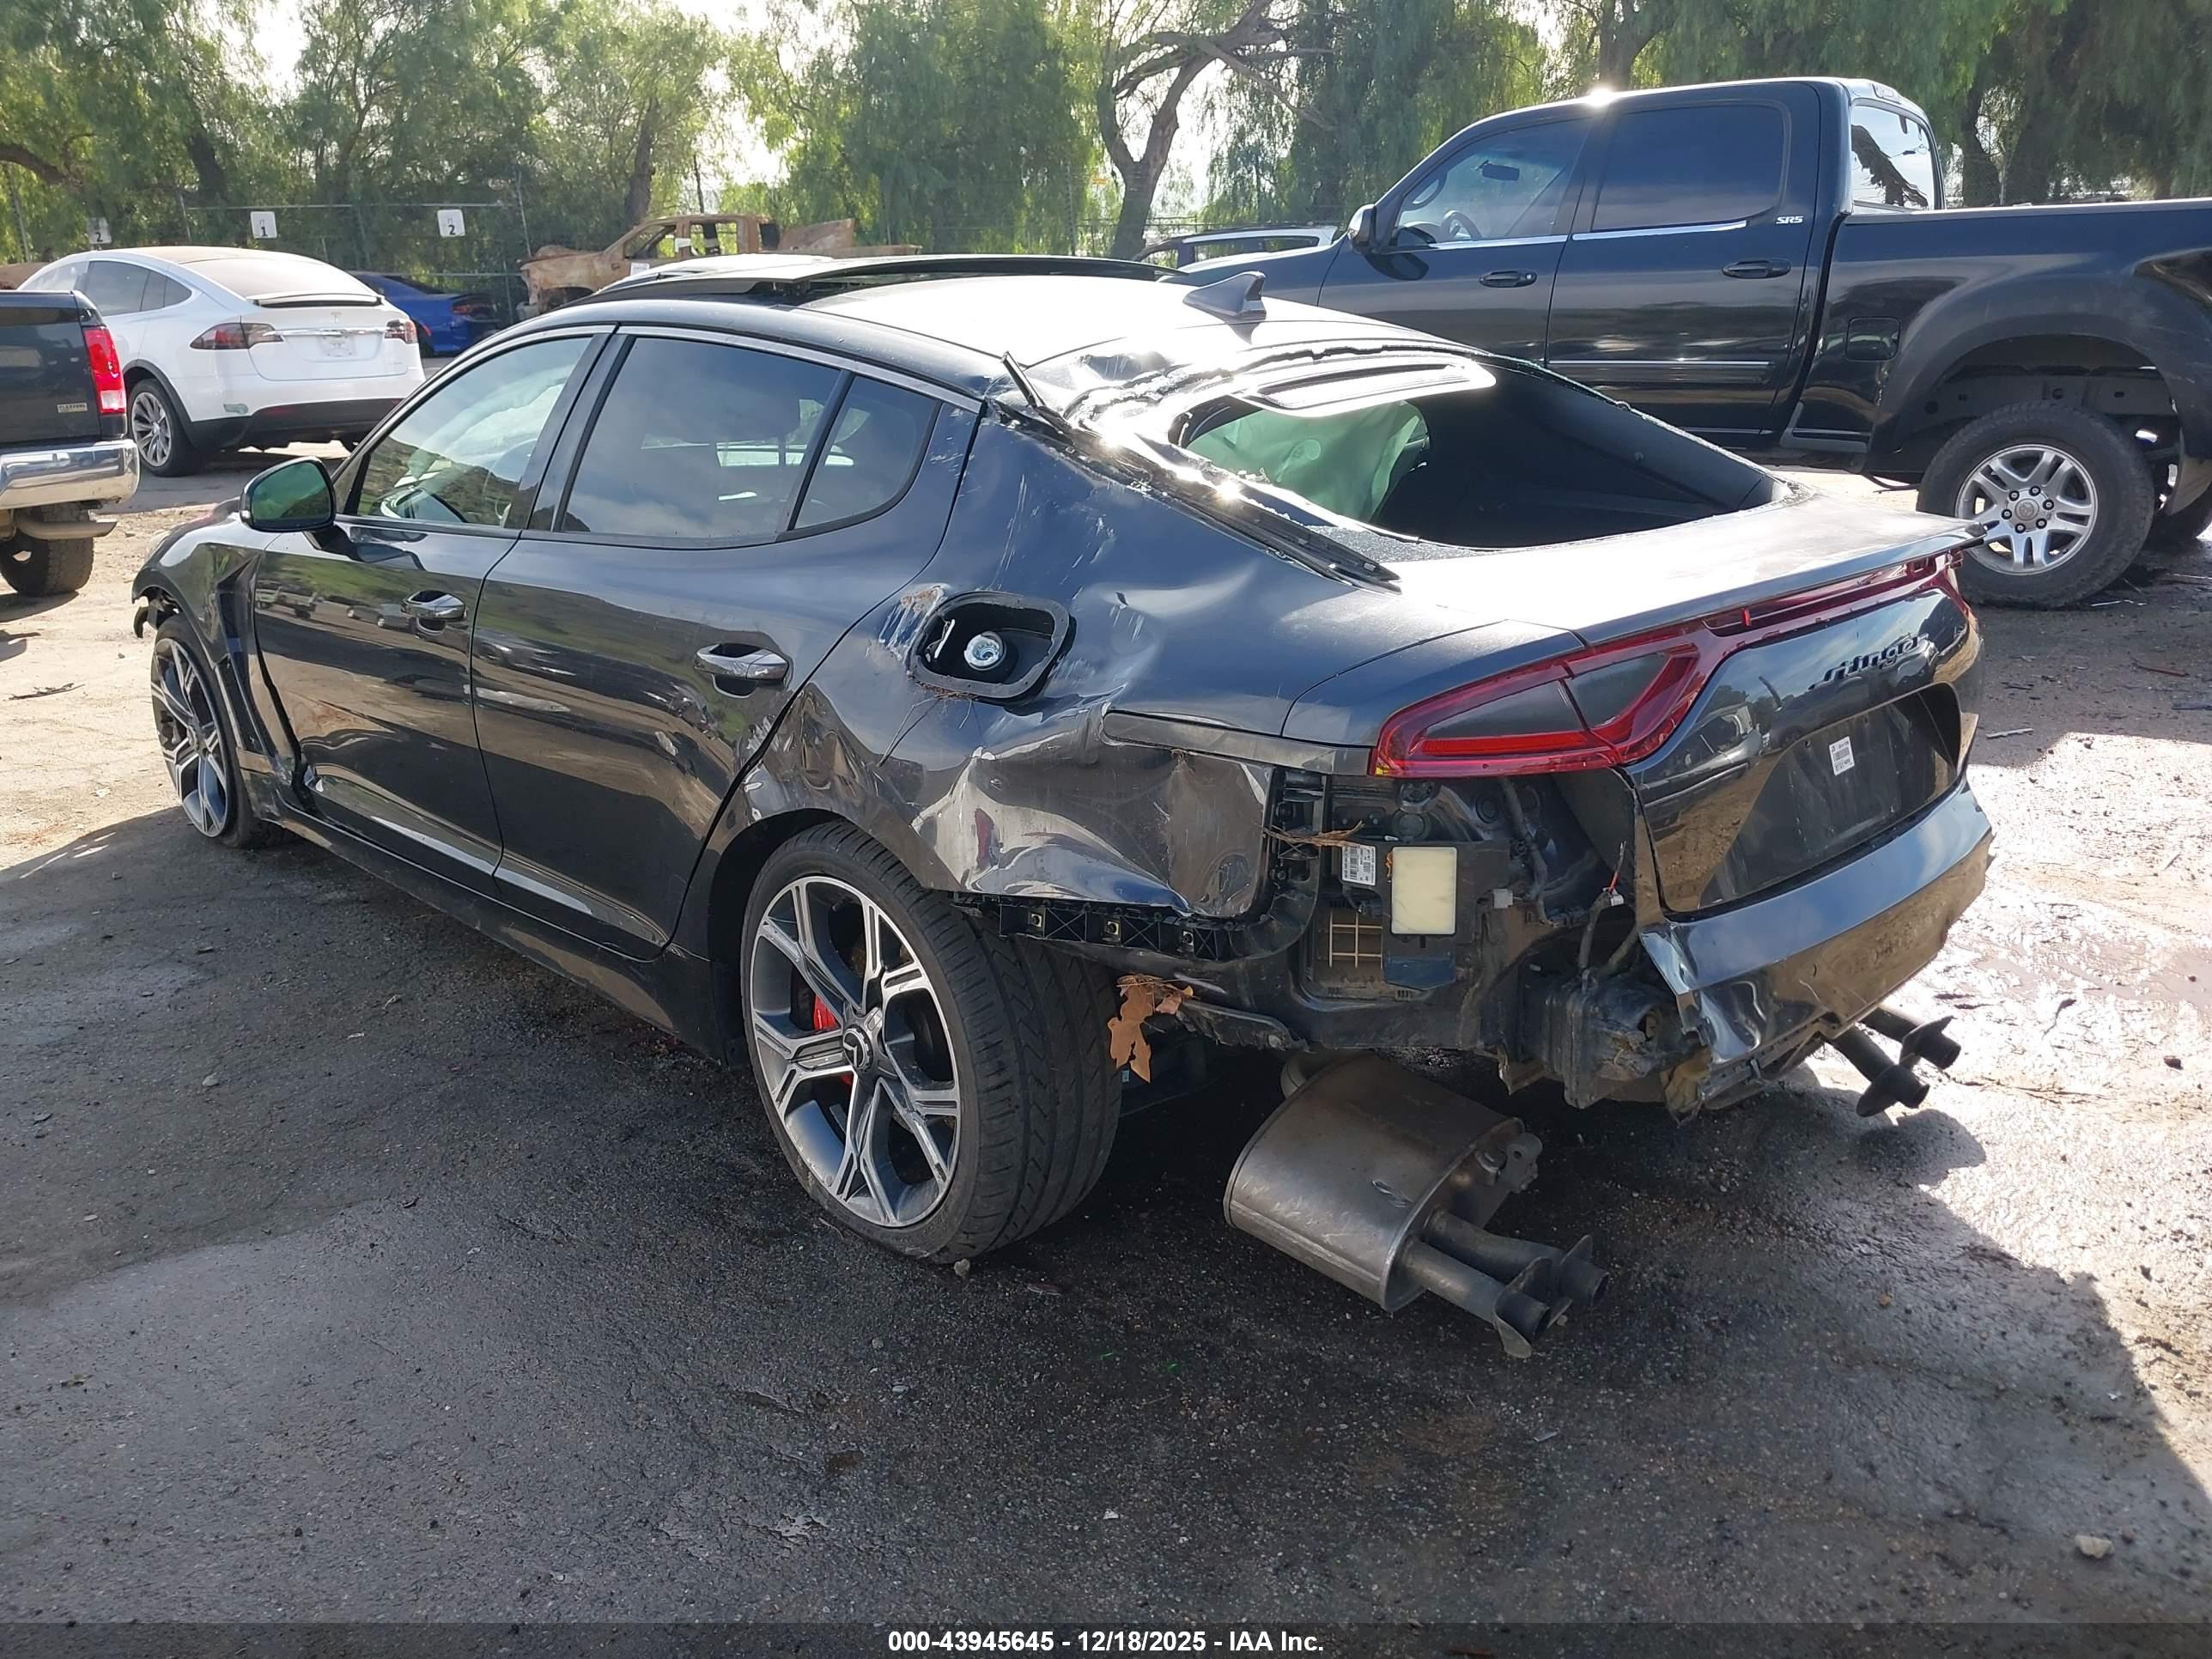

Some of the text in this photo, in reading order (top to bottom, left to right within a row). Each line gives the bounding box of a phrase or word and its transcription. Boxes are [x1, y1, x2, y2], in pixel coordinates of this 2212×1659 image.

[1775, 216, 1804, 224] SR5
[260, 226, 269, 237] 1
[448, 224, 456, 235] 2
[94, 232, 104, 242] 2
